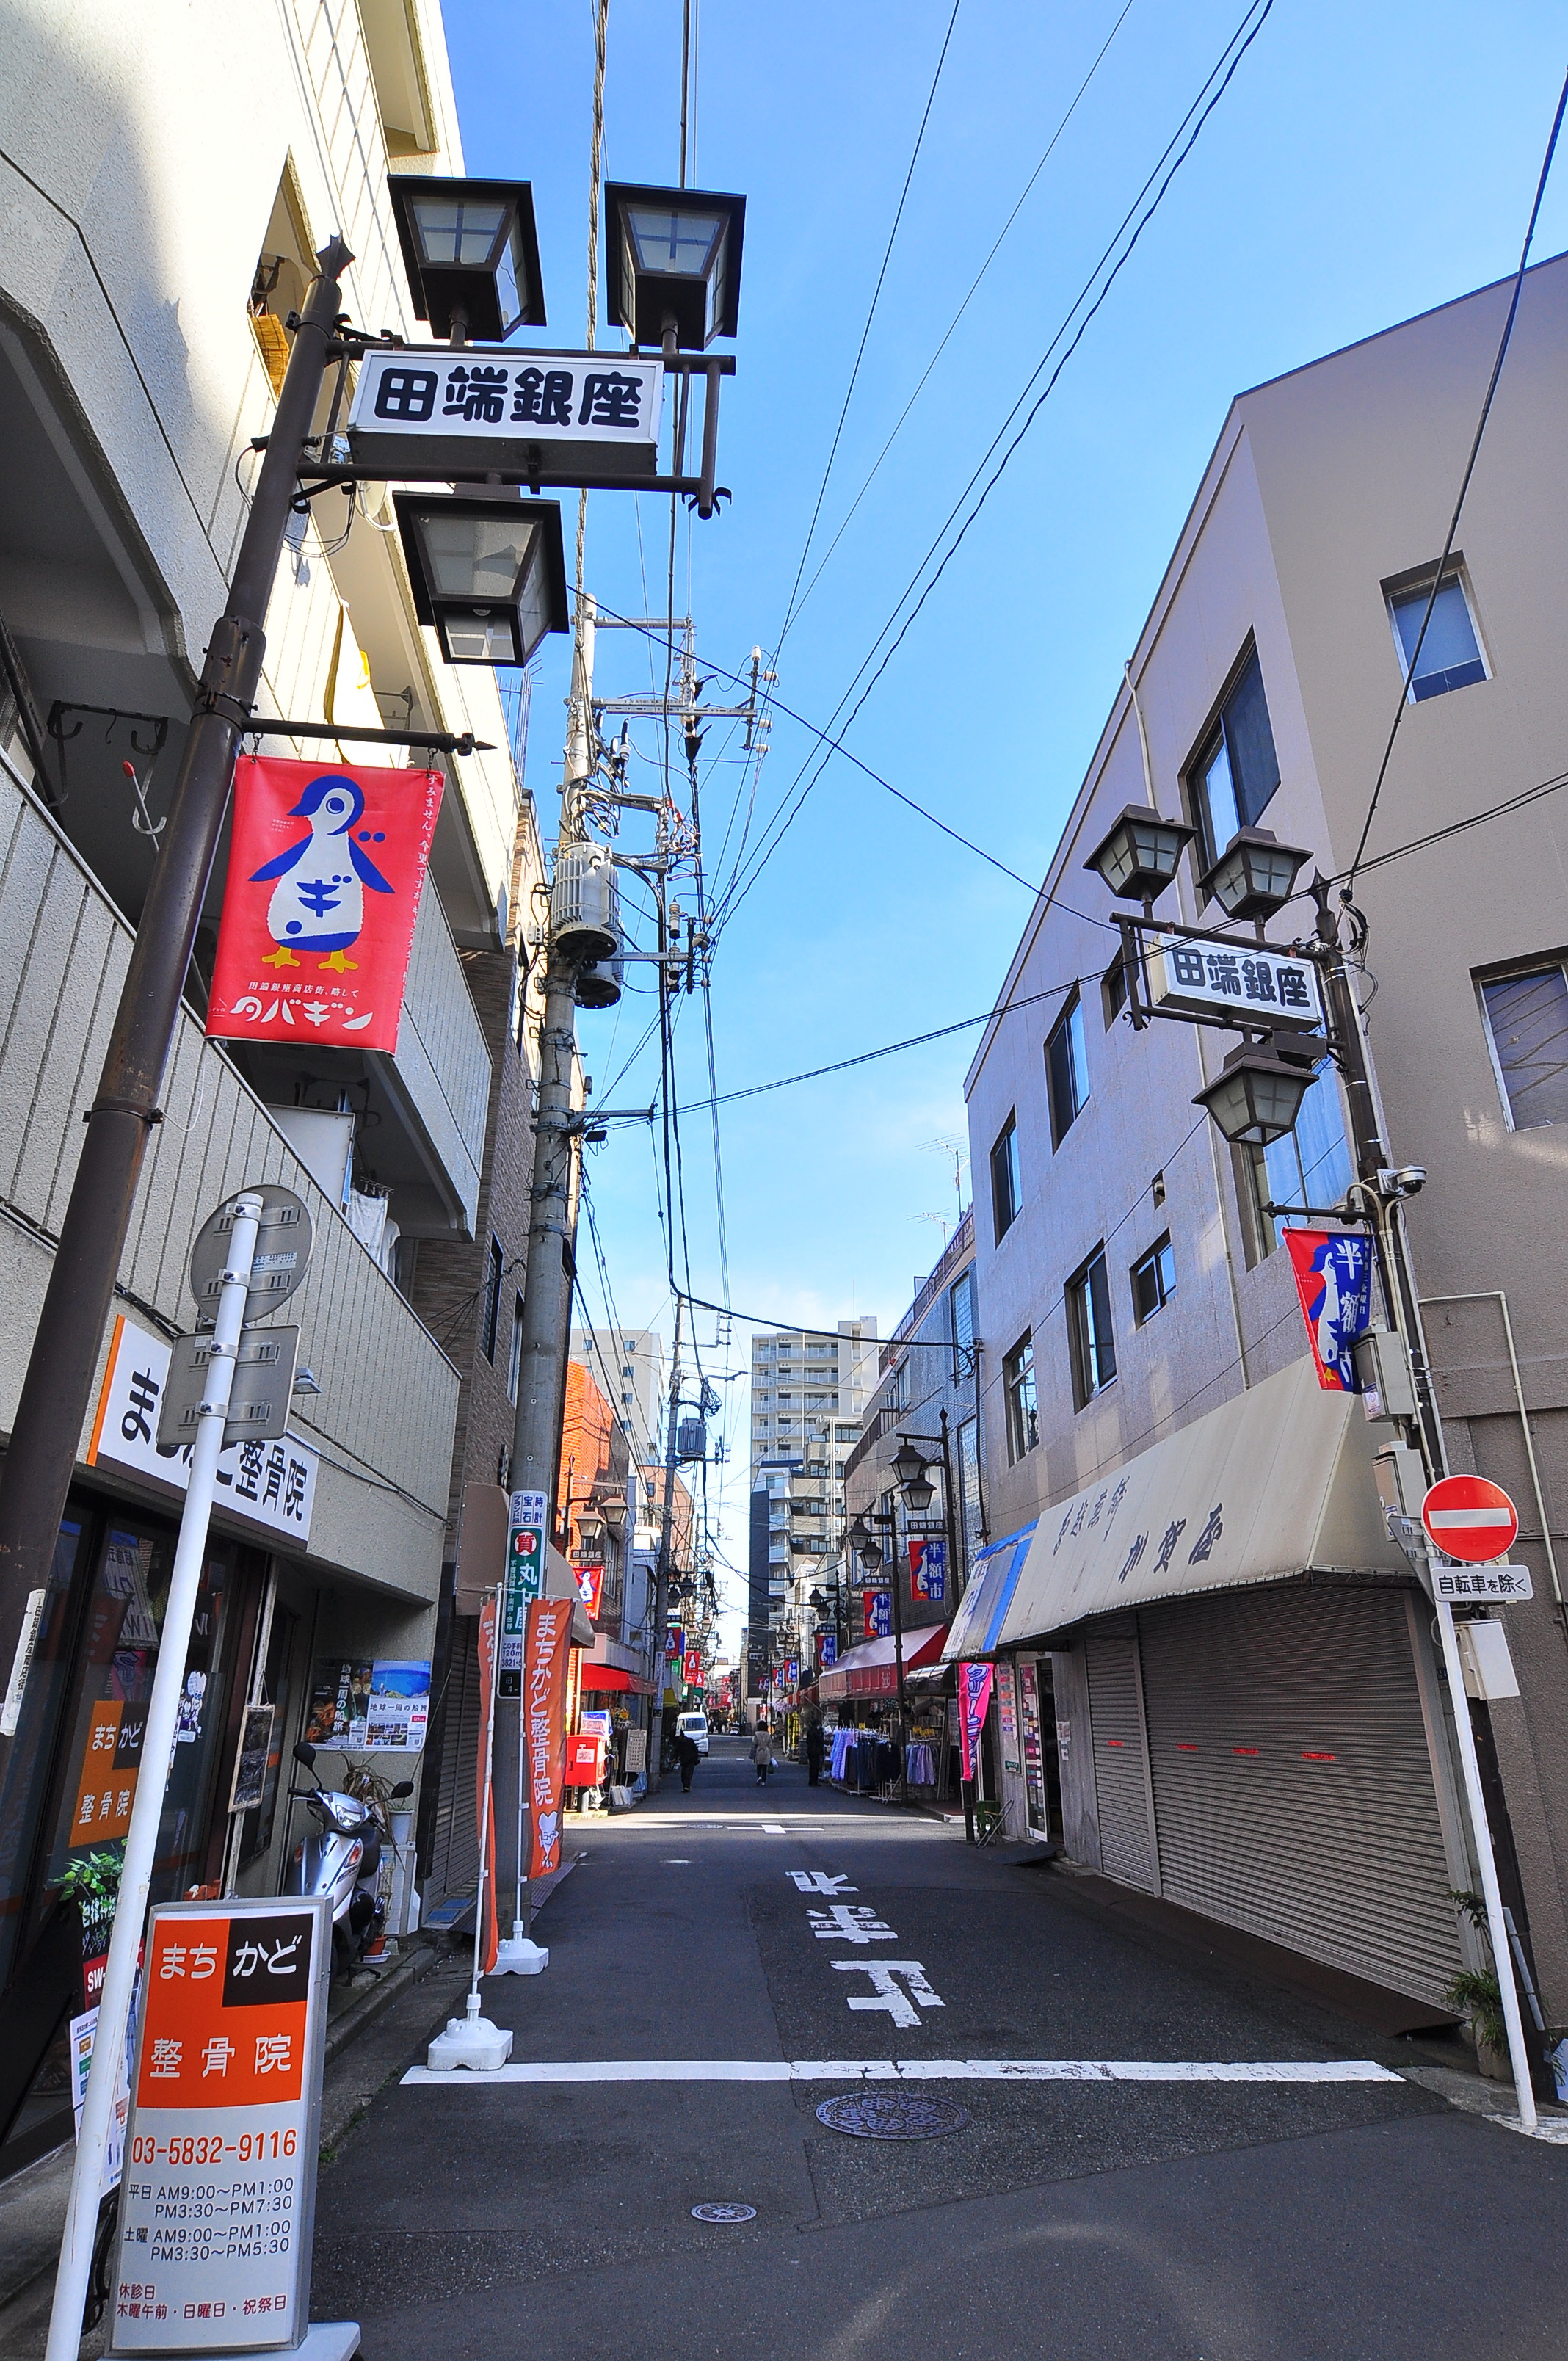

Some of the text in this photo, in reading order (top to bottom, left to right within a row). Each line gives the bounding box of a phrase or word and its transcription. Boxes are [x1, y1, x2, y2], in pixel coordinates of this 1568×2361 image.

[374, 366, 644, 428] 田端銀座
[247, 981, 360, 998] 田端銀座商店街、略して
[1172, 948, 1311, 1008] 田端銀座
[121, 1367, 308, 1522] ま整骨院
[512, 1495, 522, 1524] ブランド品
[523, 1495, 534, 1523] 宝石
[534, 1495, 544, 1524] 時計
[517, 1534, 534, 1553] 質
[928, 1542, 943, 1599] 半額市
[1438, 1573, 1528, 1595] 自転車を除く
[877, 1594, 888, 1636] 半額市
[333, 1663, 352, 1732] 地球一周の船旅
[370, 1702, 427, 1712] 地球一周の船旅
[529, 1612, 556, 1808] まちかど整骨院
[91, 1721, 143, 1751] まちかど
[79, 1789, 133, 1825] 整骨院
[159, 1933, 302, 1981] まちかど
[785, 1871, 946, 2028] 止まれ
[150, 2032, 292, 2079] 整骨院
[132, 2128, 298, 2165] 03-5832-9116
[128, 2183, 152, 2200] 平日
[123, 2226, 148, 2244] 土曜
[117, 2294, 287, 2320] 木曜午前・日曜日・祝祭日
[119, 2282, 156, 2300] 休診日
